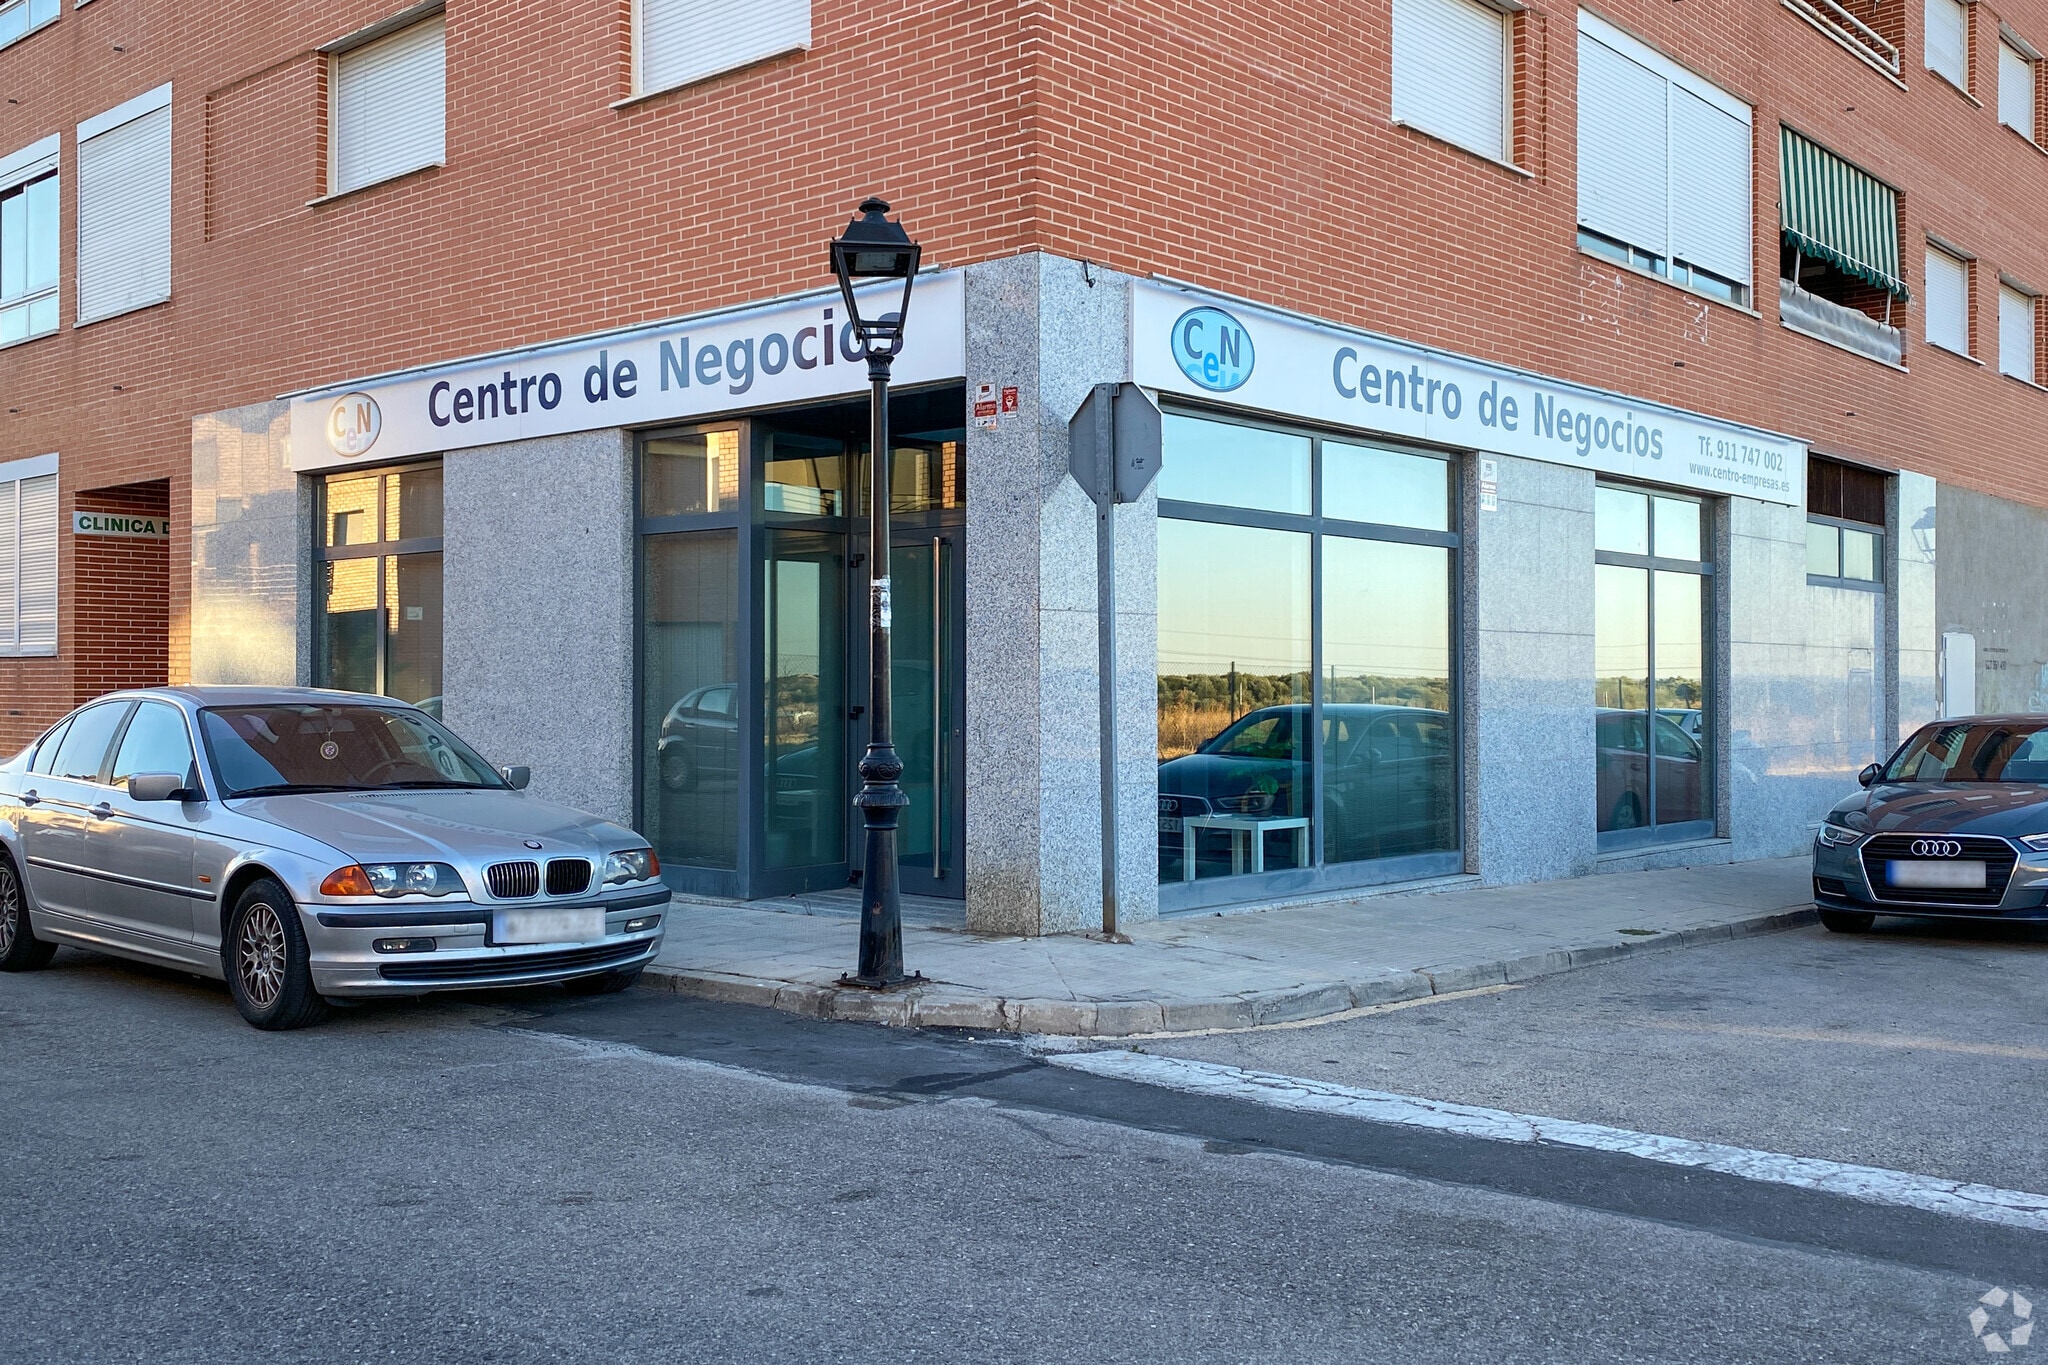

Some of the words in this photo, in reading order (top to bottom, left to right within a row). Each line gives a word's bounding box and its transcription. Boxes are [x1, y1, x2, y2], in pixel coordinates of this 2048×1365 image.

[428, 370, 562, 428] Centro
[583, 350, 638, 402] de
[1332, 346, 1462, 420] Centro
[1478, 380, 1519, 432] de
[1534, 392, 1664, 461] Negocios
[1698, 435, 1713, 457] Tf.
[1717, 439, 1738, 463] 911
[1741, 445, 1761, 467] 747
[1764, 450, 1783, 472] 002
[1689, 462, 1790, 493] www.centro-empresas.es
[78, 516, 156, 534] CLINICA
